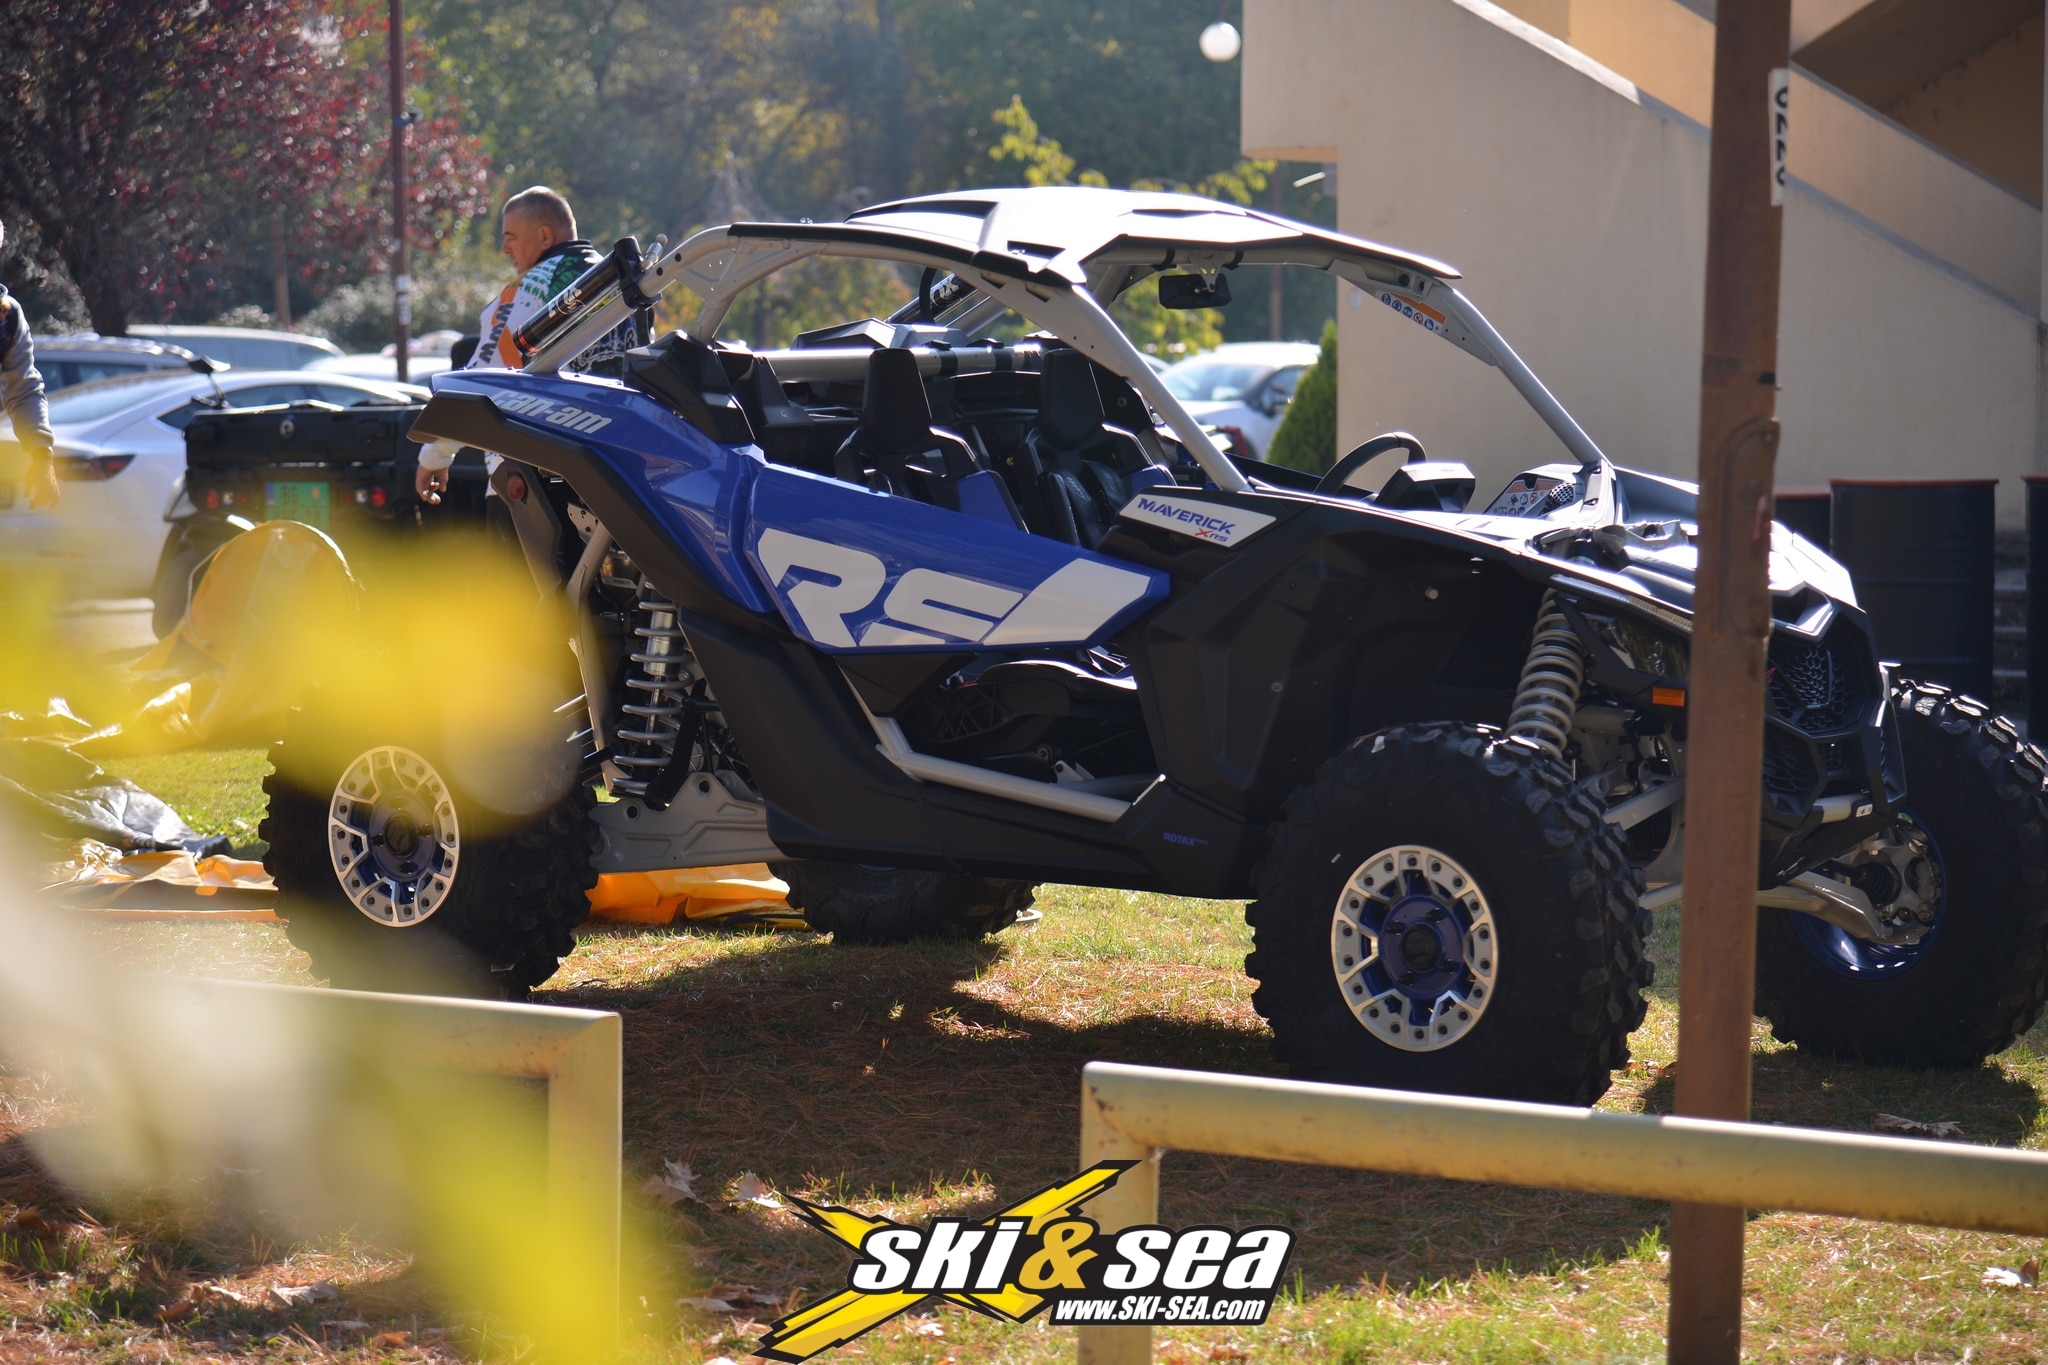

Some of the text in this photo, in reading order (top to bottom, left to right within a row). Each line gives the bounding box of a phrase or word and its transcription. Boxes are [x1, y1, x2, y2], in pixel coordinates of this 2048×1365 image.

[1137, 497, 1237, 535] MAVERICK
[757, 527, 1024, 648] RS
[1163, 832, 1196, 847] ROTAX
